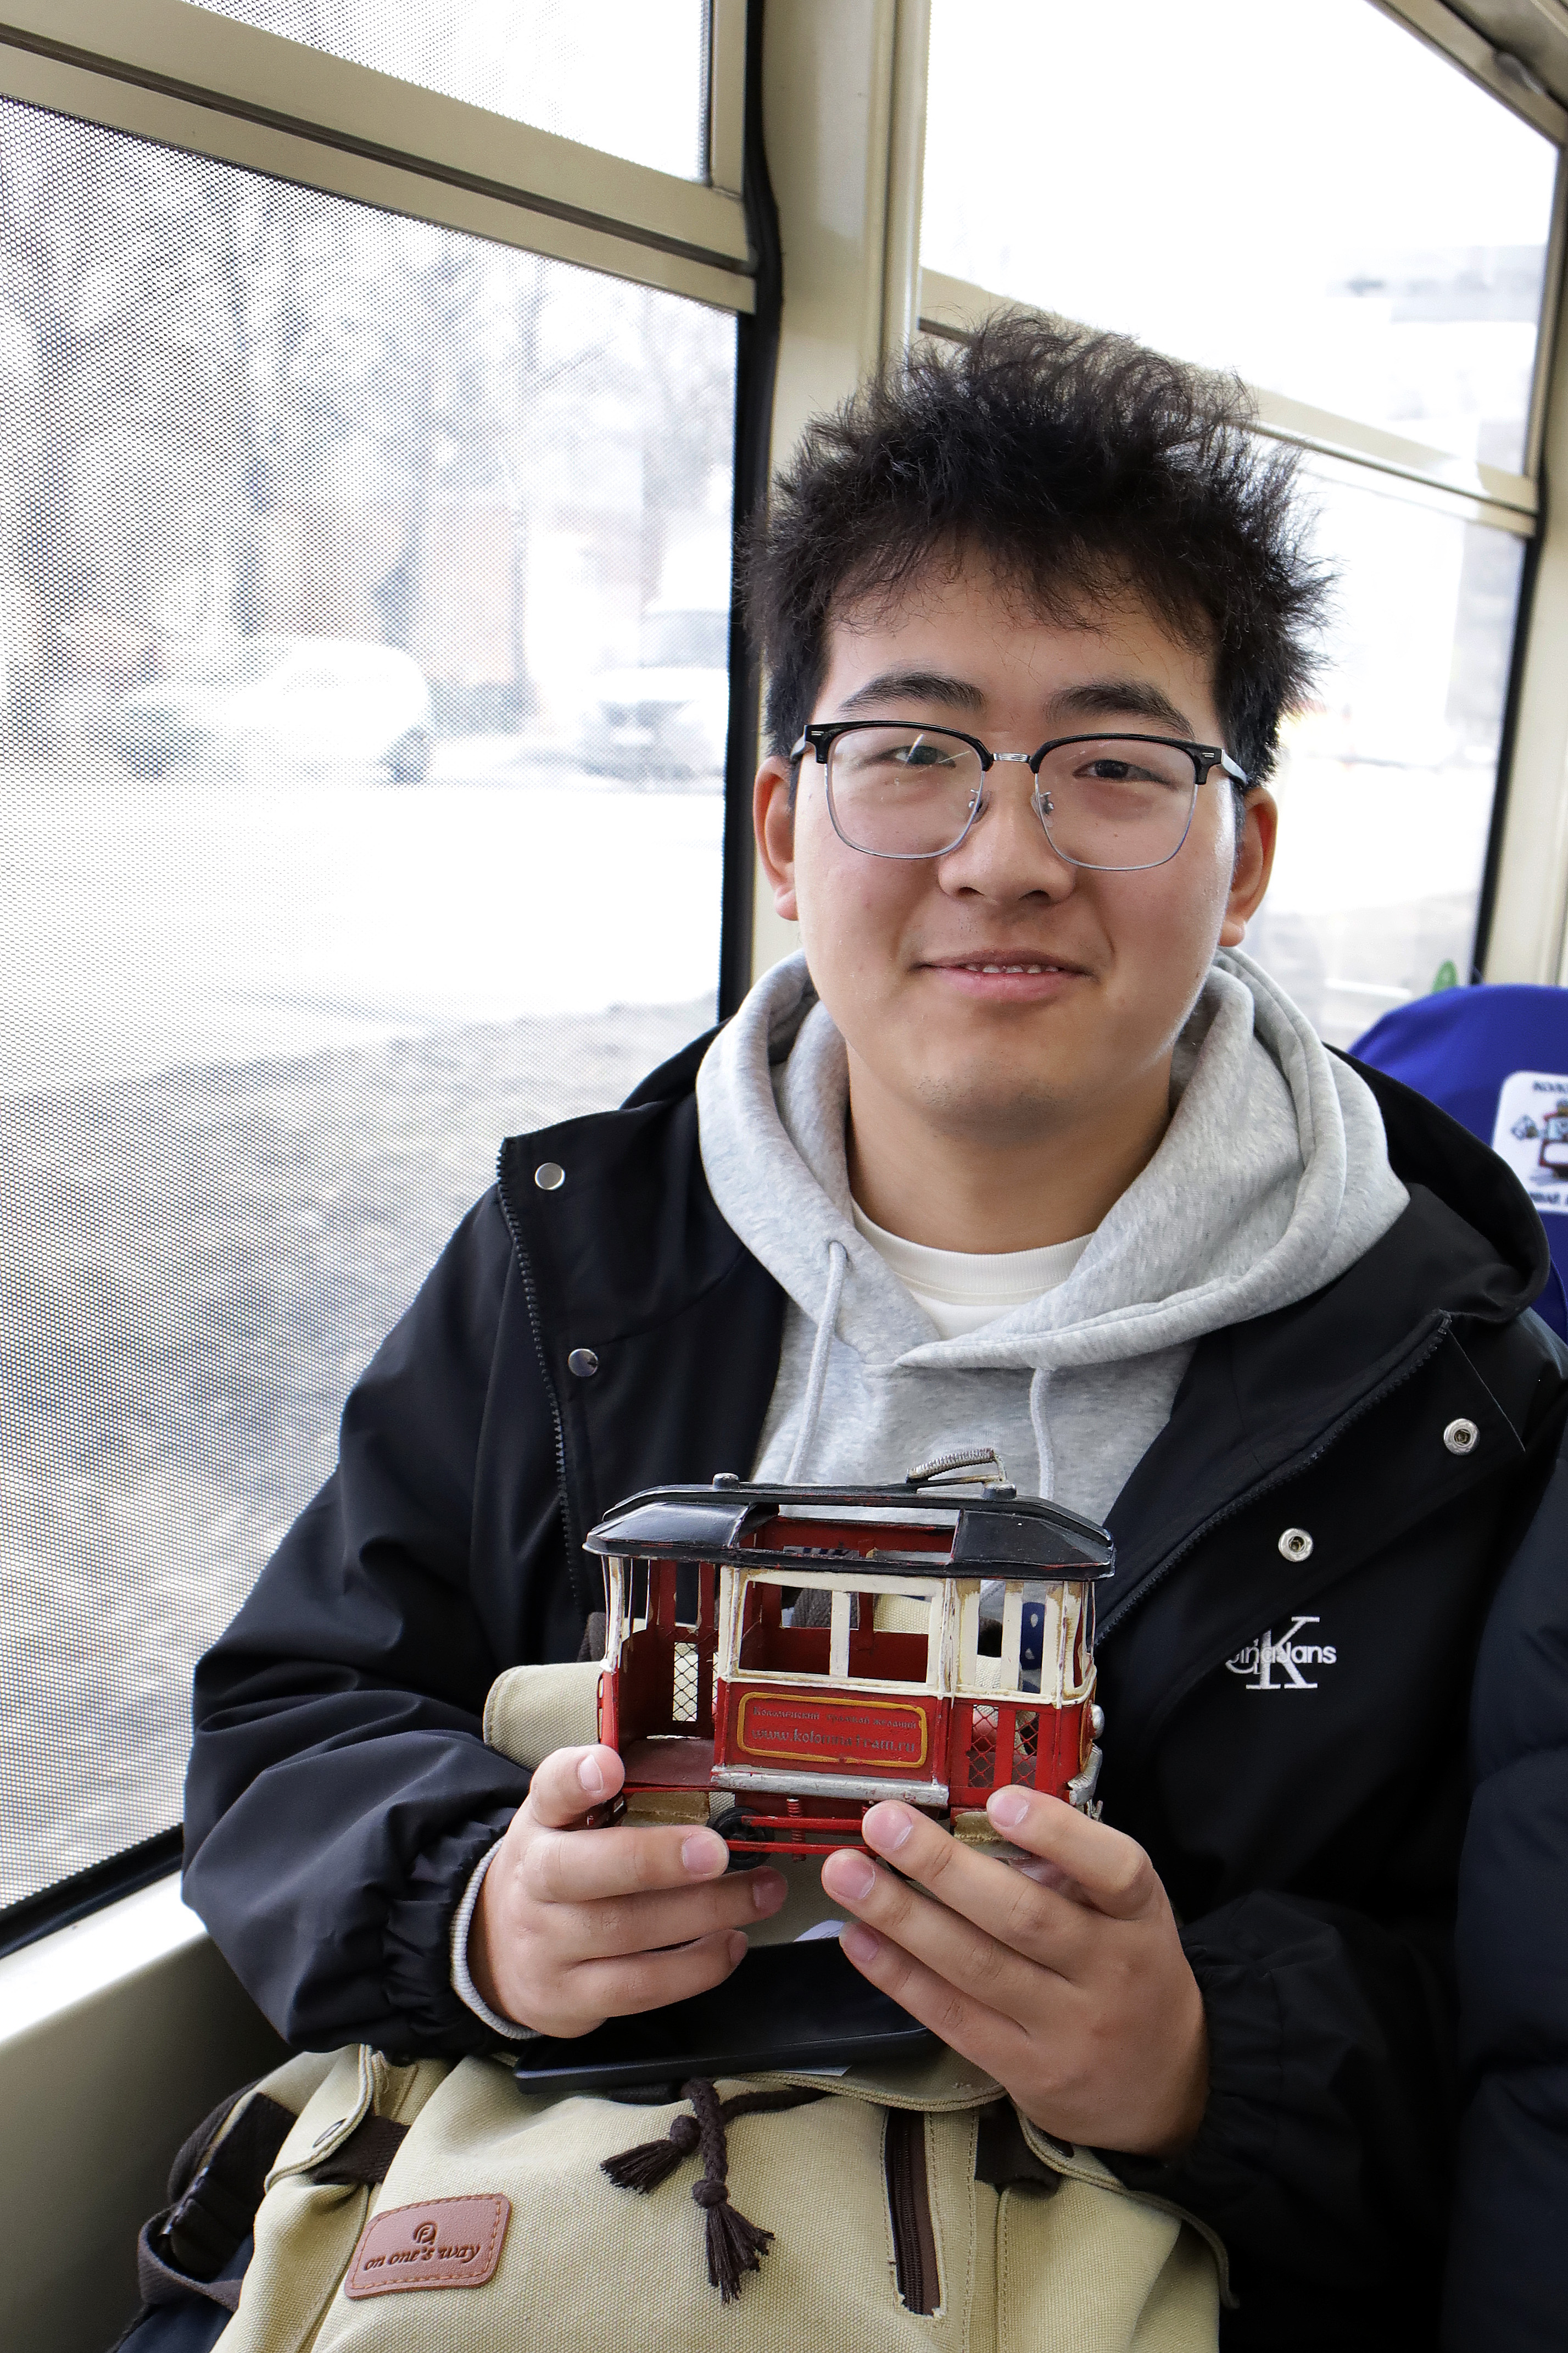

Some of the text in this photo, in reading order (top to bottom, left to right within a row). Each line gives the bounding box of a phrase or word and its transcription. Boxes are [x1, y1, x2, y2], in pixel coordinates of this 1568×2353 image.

[364, 2243, 481, 2271] on one's way
